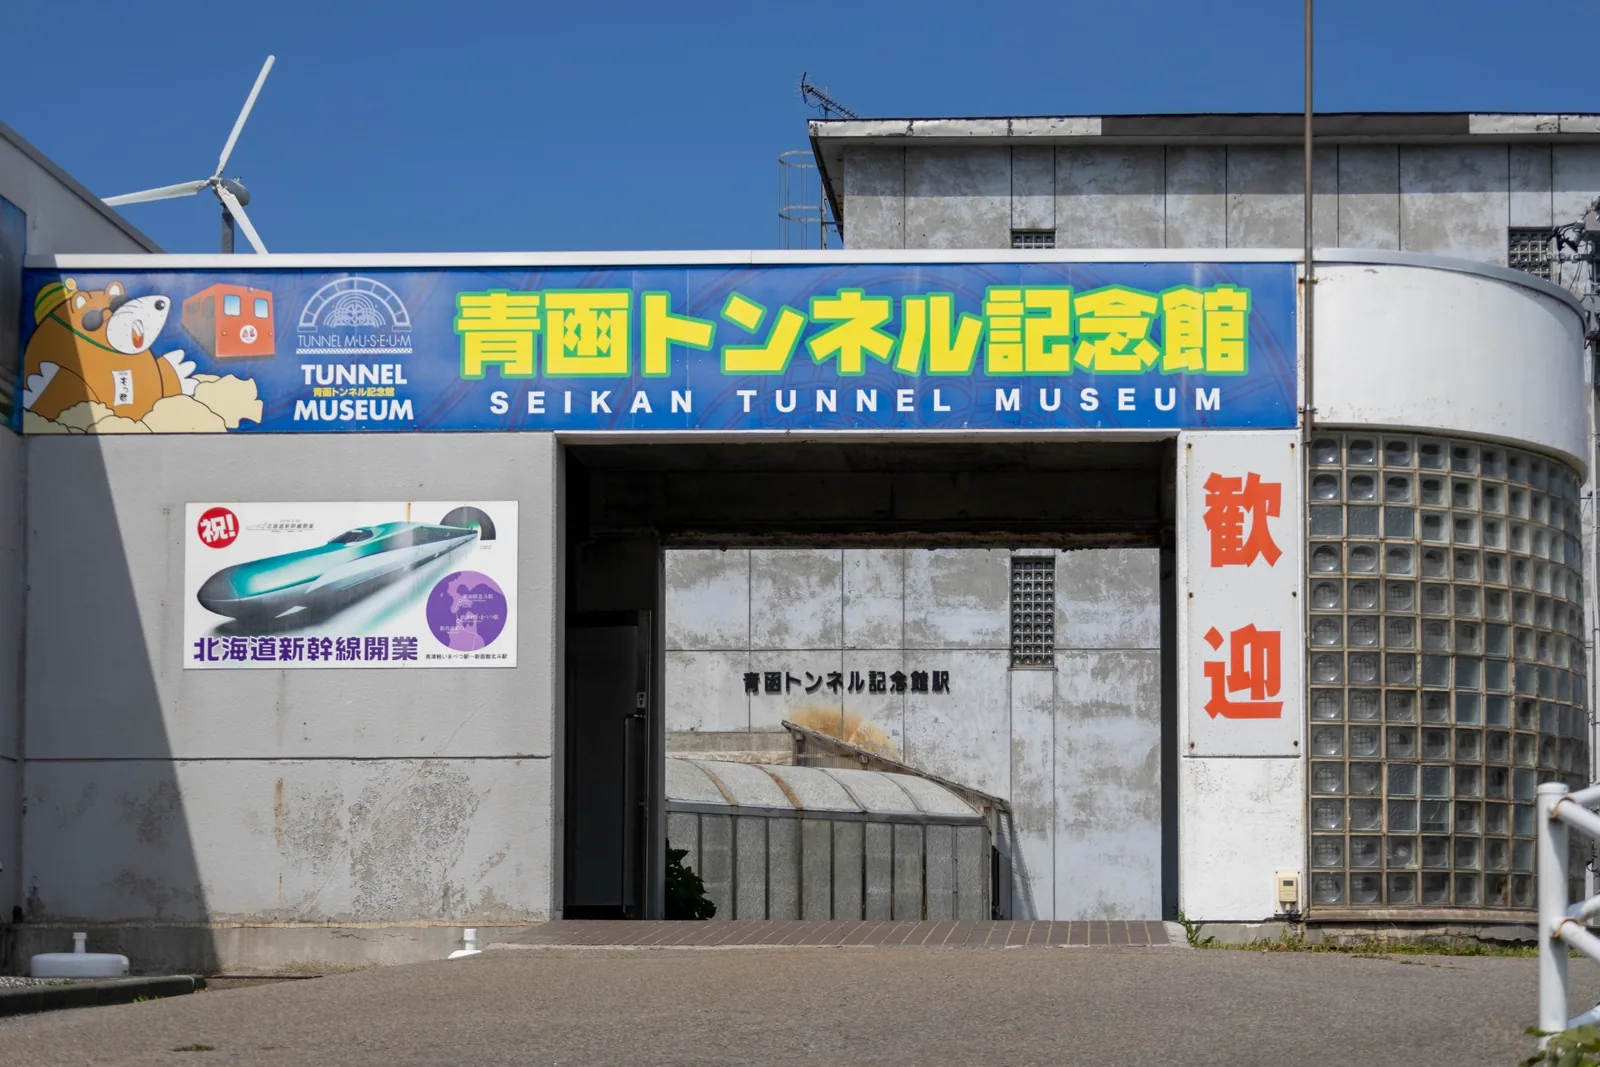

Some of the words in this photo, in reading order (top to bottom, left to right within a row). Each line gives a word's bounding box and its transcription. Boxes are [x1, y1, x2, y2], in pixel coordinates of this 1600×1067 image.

[297, 335, 341, 347] TUNNEL
[455, 286, 1251, 379] 青函トンネル記念館
[301, 364, 408, 385] TUNNEL
[313, 387, 395, 397] 青函トンネル記念館
[490, 390, 692, 414] SEIKAN
[737, 389, 951, 412] TUNNEL
[995, 387, 1221, 411] MUSEUM
[293, 399, 414, 420] MUSEUM
[1203, 472, 1284, 720] 歓迎
[193, 636, 418, 662] 北海道新幹線開業
[743, 670, 950, 693] 青函トンネル記念館駅
